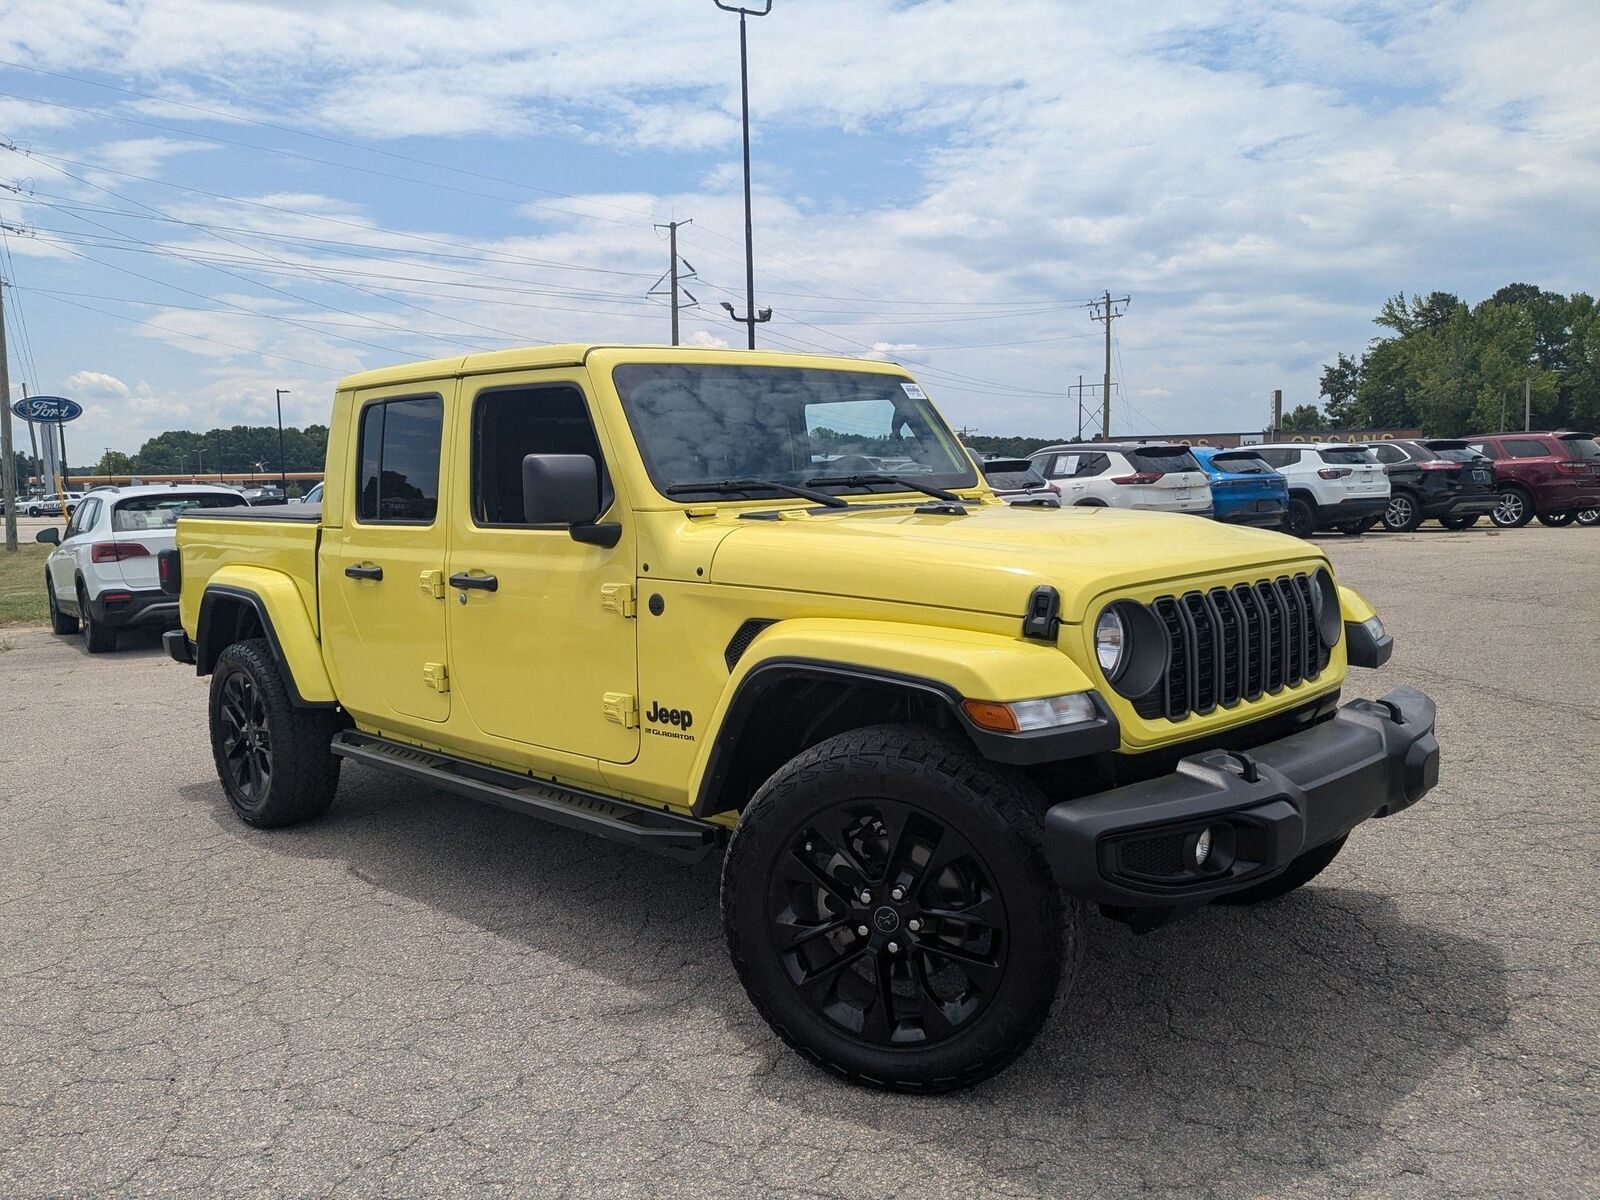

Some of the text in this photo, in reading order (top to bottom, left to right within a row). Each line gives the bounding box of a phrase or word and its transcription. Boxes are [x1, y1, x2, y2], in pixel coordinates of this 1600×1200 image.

[30, 400, 69, 417] Ford
[646, 700, 693, 731] Jeep
[652, 728, 695, 741] GLADIATOR
